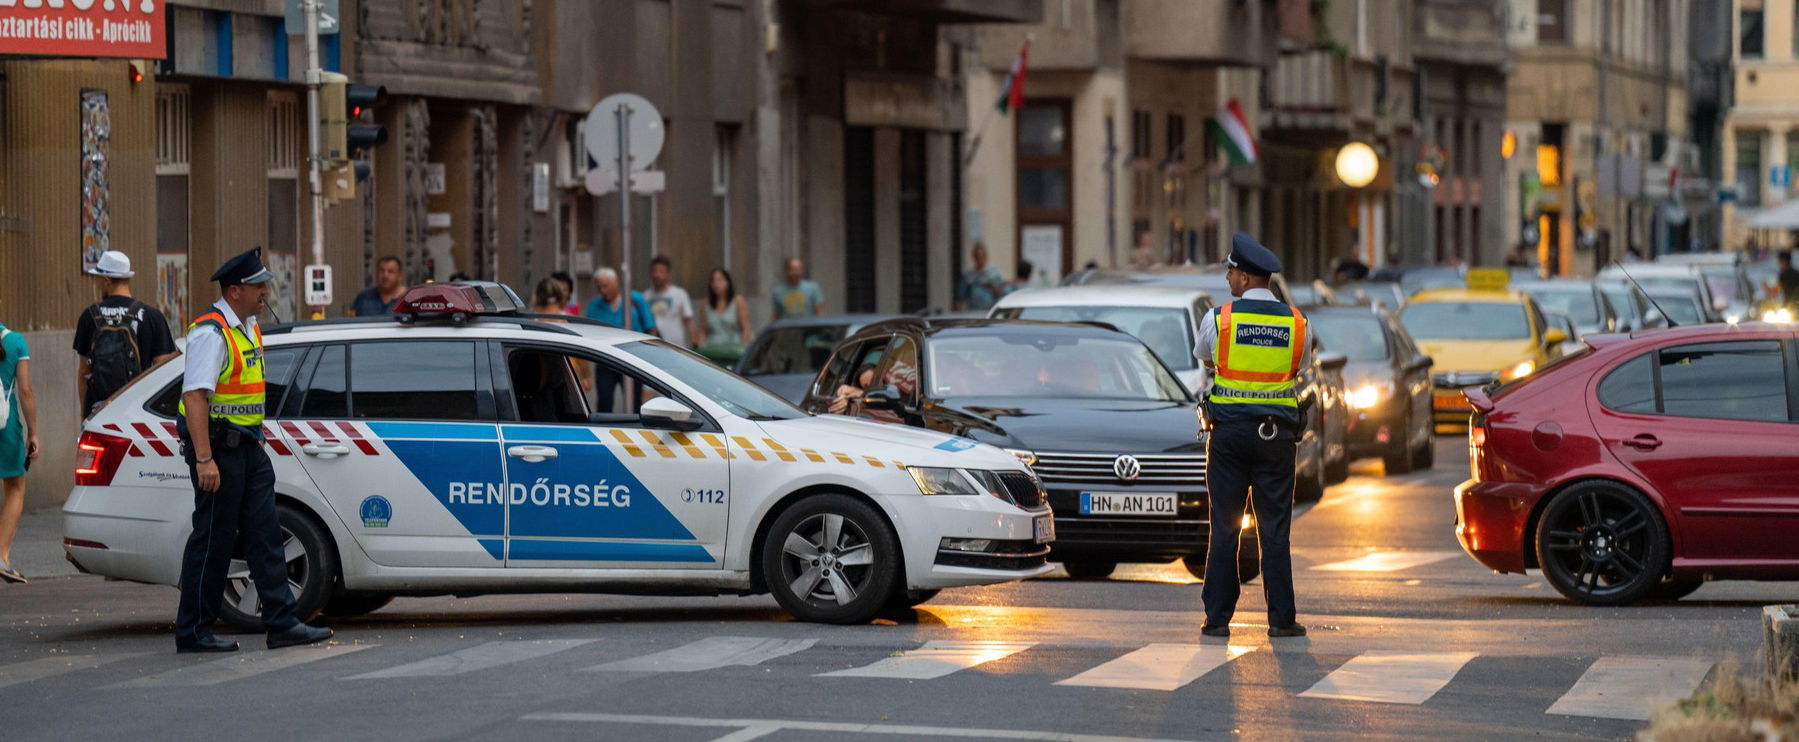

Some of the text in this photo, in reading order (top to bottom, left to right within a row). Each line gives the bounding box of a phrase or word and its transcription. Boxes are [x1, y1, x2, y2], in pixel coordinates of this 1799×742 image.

[0, 15, 62, 39] ztartási
[65, 17, 94, 41] cikk
[103, 18, 152, 43] Aprócikk
[1252, 338, 1273, 346] POLICE
[1217, 386, 1249, 398] OLICE
[1251, 390, 1290, 398] POLICE
[208, 405, 263, 414] ICE POLICE
[449, 478, 630, 508] RENDŐRSÉG
[696, 489, 725, 504] 112
[1091, 496, 1175, 512] HN AN 101
